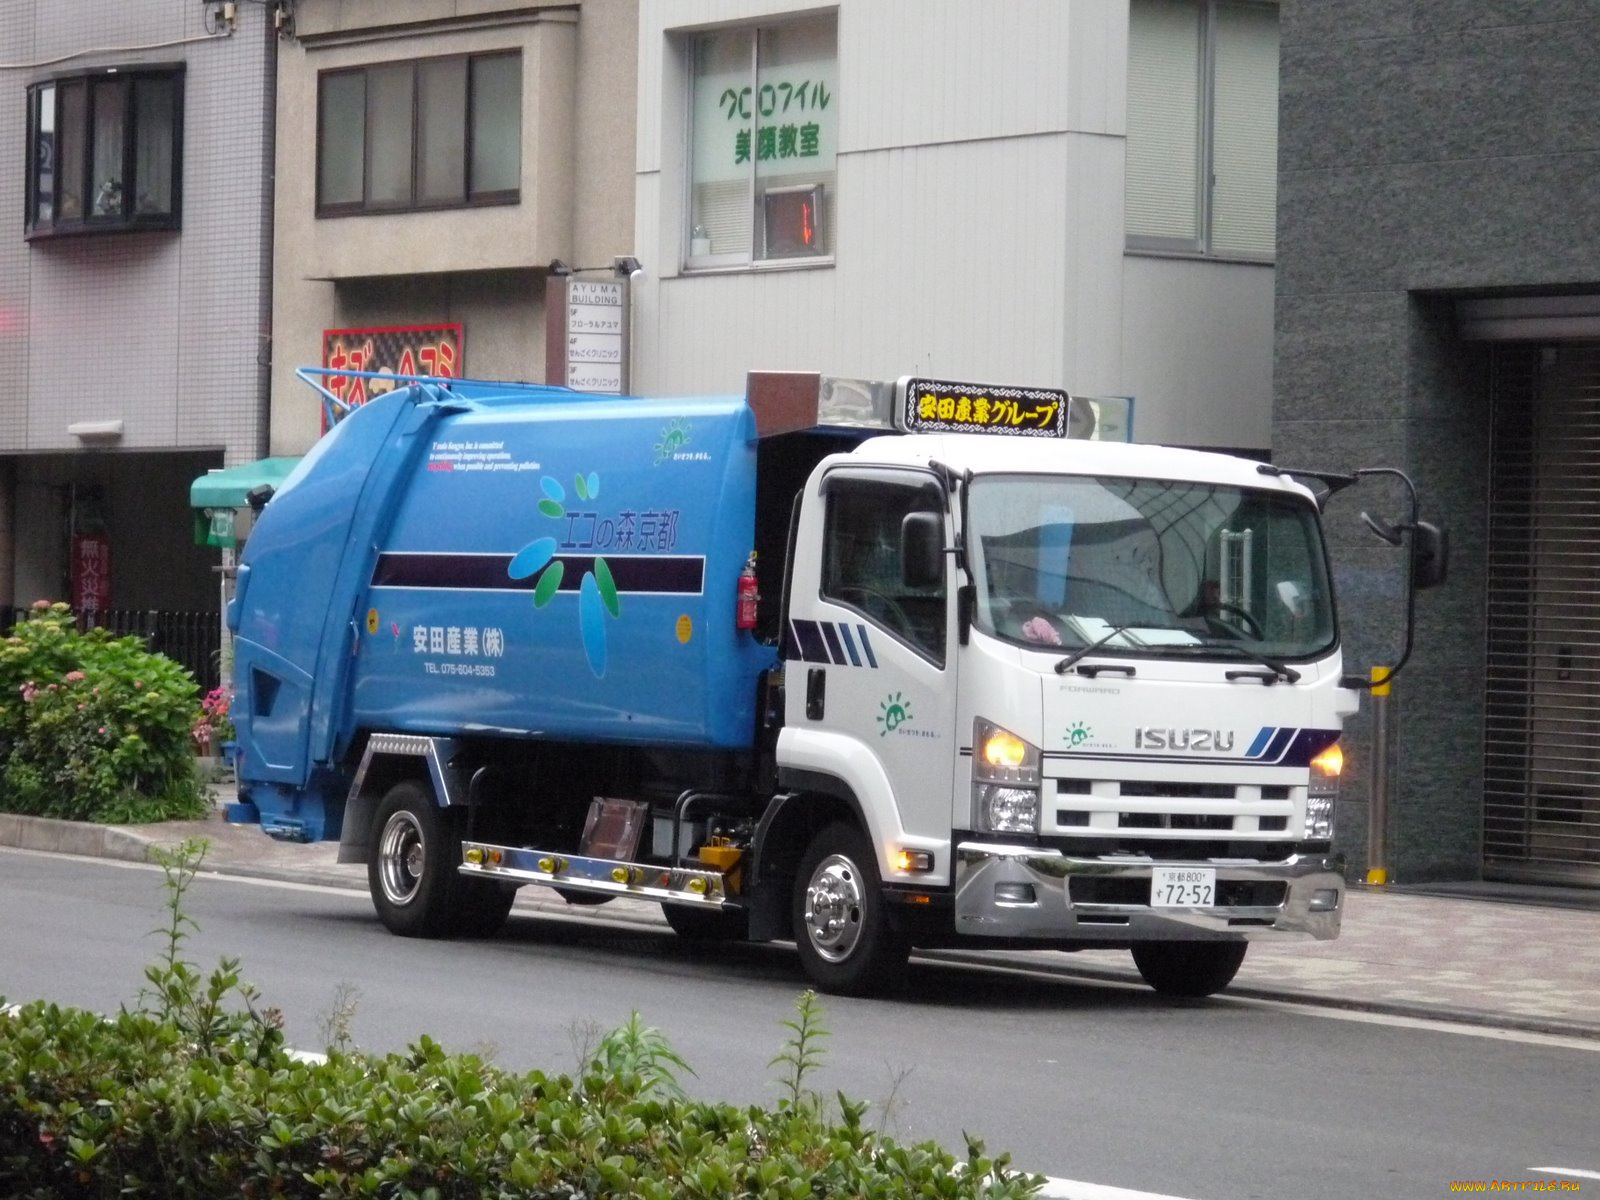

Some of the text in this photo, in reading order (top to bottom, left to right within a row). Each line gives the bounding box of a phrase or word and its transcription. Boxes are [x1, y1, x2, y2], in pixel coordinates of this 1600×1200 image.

[571, 295, 618, 304] BUILDING
[572, 284, 618, 294] AYUMA
[918, 394, 1059, 428] 安田産業グループ
[561, 510, 679, 551] エコの森京都
[1135, 727, 1234, 751] ISUZU
[1166, 885, 1212, 905] 72-52
